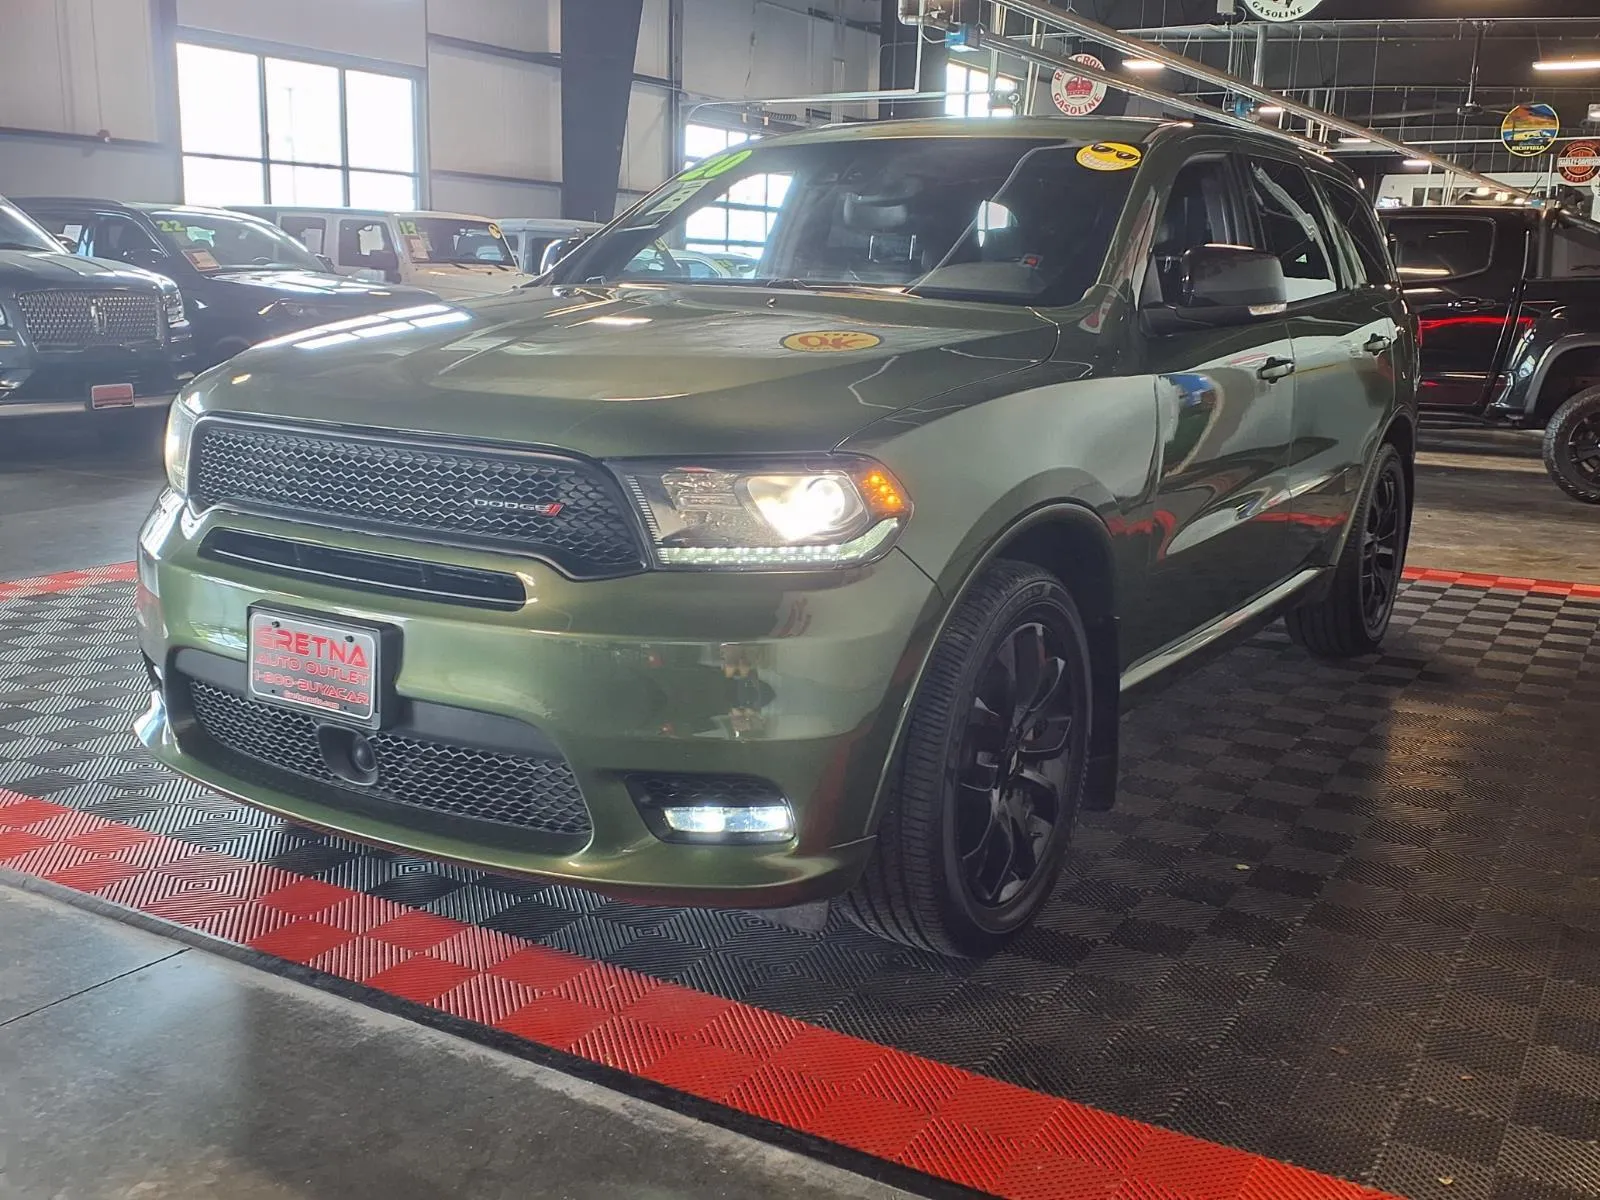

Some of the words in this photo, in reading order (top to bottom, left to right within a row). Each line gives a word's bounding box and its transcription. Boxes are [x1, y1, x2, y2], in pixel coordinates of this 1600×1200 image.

[1252, 1, 1304, 18] GASOLINE
[1075, 55, 1101, 70] CRO
[1054, 92, 1101, 115] GASOLINE
[156, 220, 186, 232] 22
[474, 499, 549, 512] DODGE
[255, 653, 301, 670] AUTO
[304, 660, 369, 686] OUTLET
